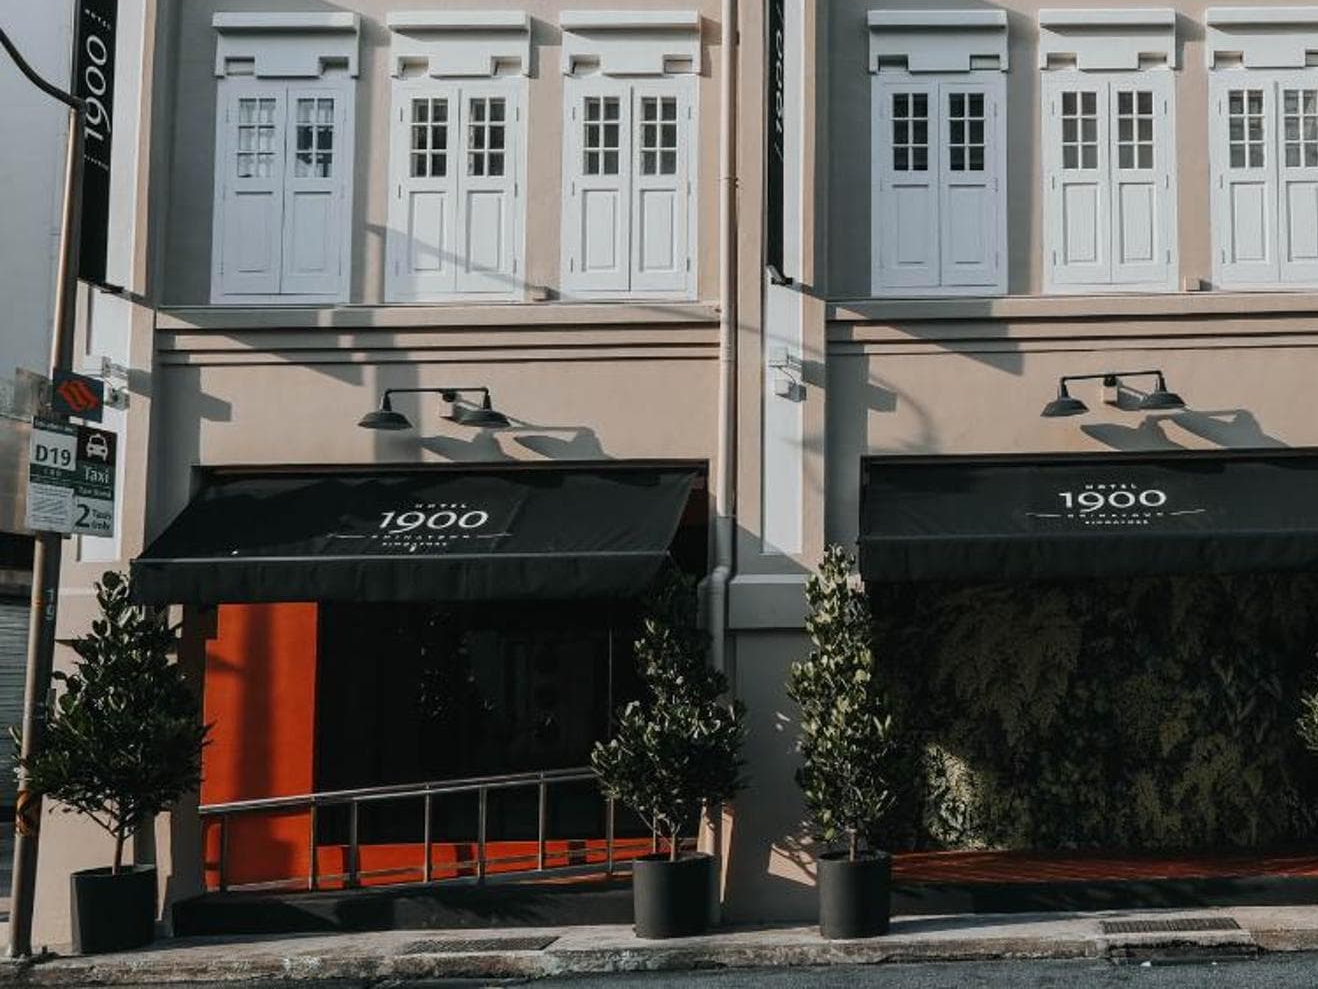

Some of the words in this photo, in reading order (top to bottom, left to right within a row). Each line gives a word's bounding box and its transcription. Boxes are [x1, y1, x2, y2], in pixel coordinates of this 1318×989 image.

[85, 34, 112, 141] 1900
[35, 444, 71, 467] D19
[84, 465, 110, 484] Taxi
[1058, 489, 1167, 513] 1900
[75, 503, 91, 528] 2
[379, 510, 489, 535] 1900
